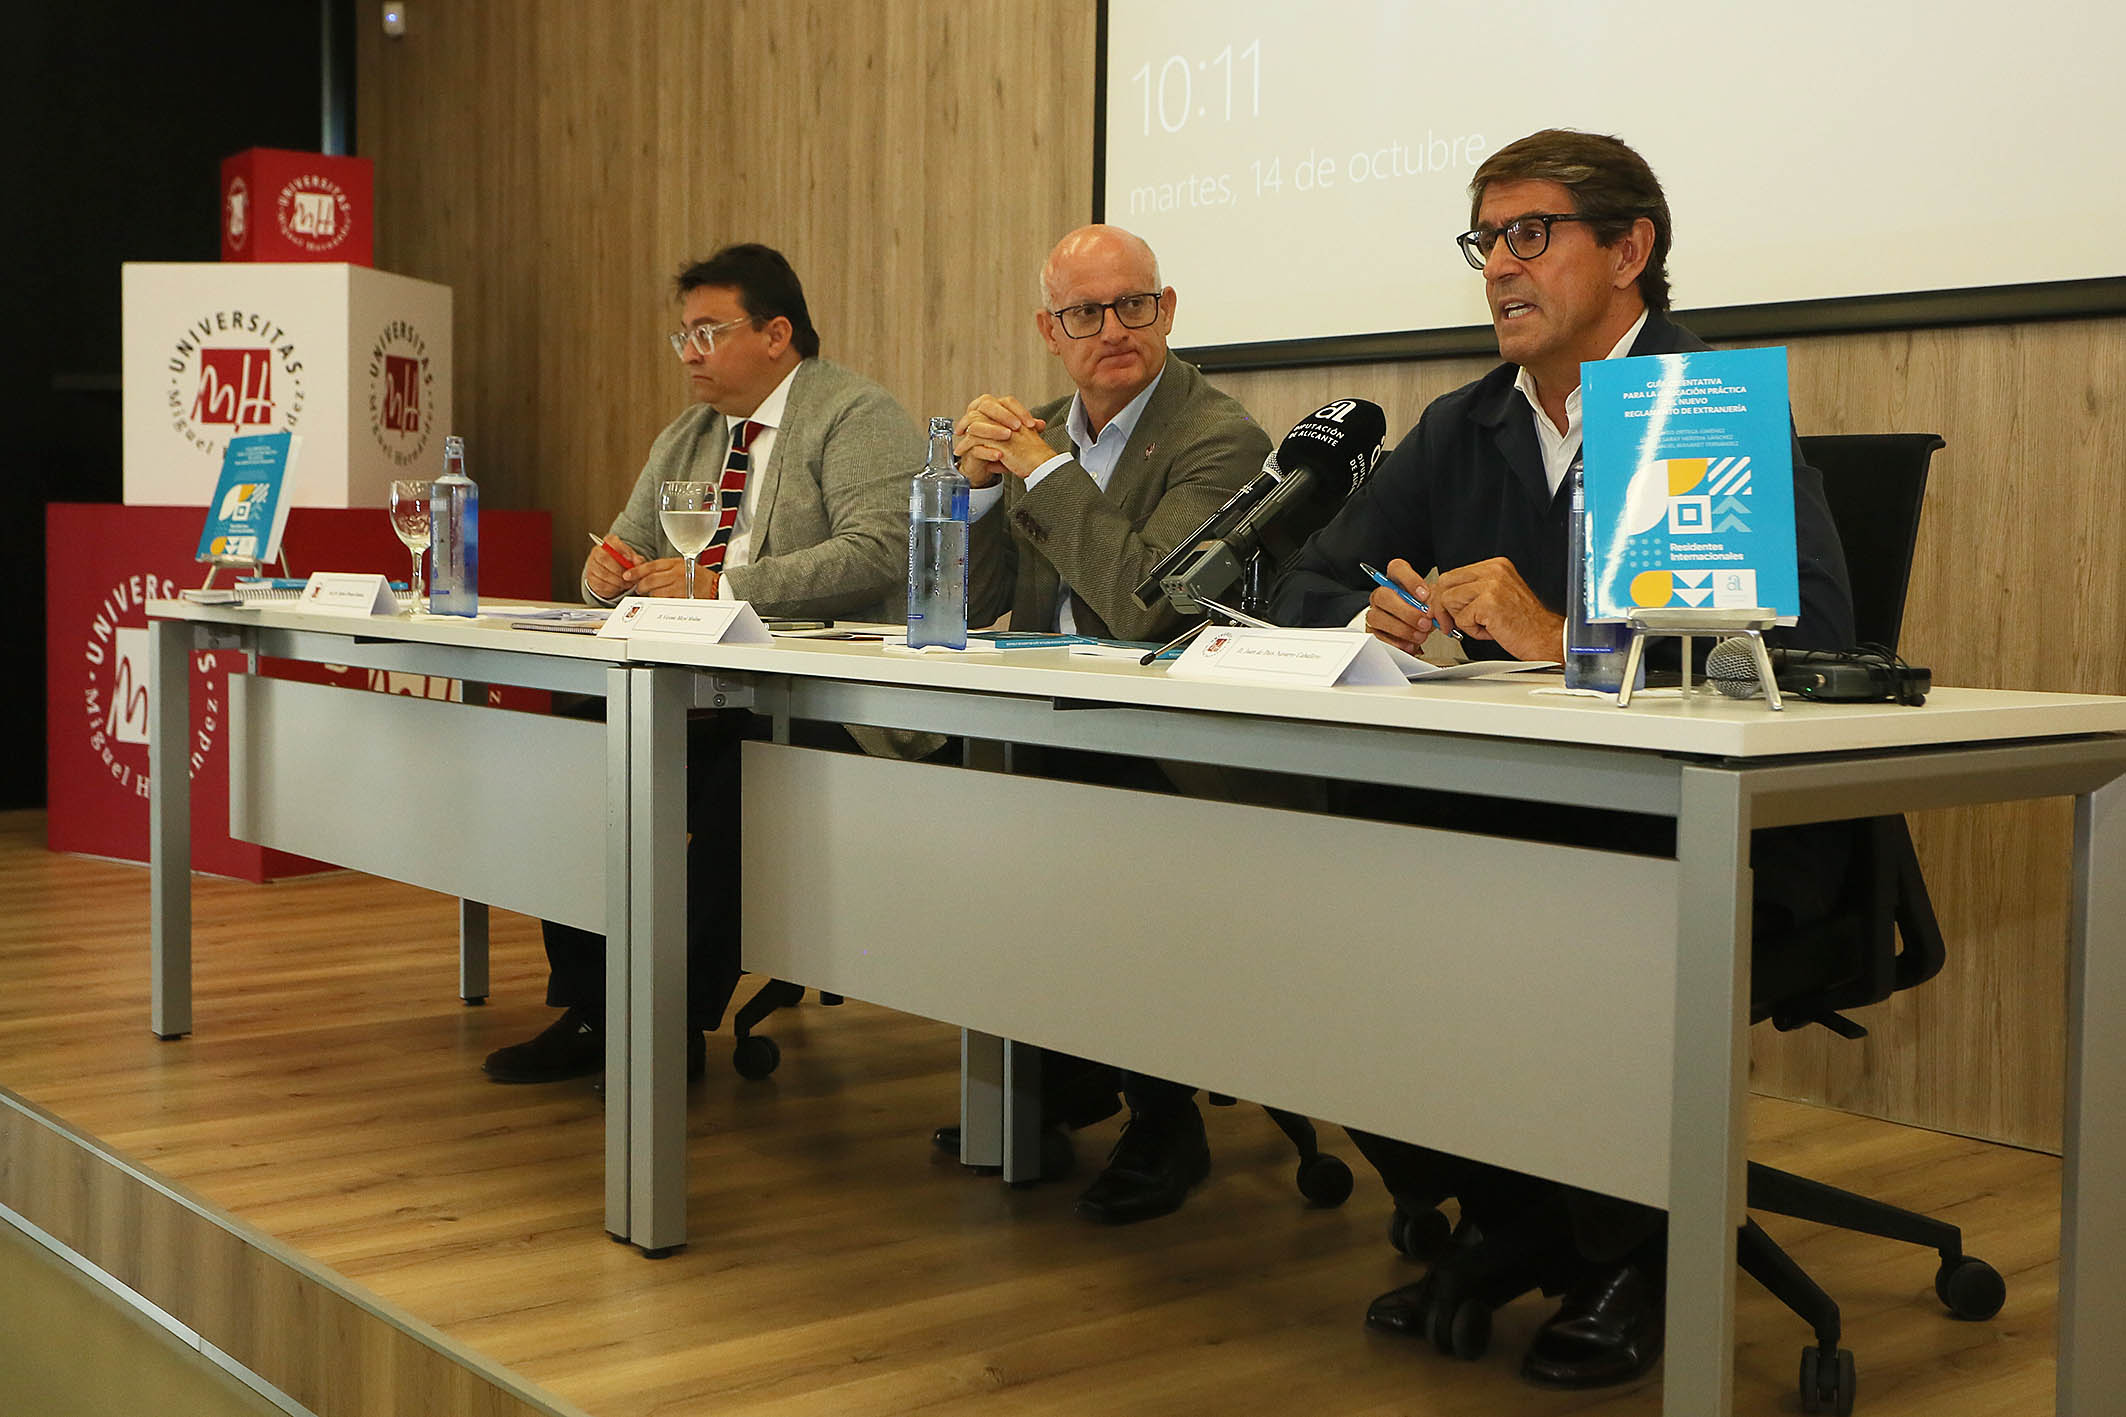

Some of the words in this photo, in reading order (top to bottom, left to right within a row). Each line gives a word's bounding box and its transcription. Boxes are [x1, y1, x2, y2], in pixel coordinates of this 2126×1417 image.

[1132, 39, 1262, 136] 10:11
[1130, 172, 1240, 215] martes,
[1249, 156, 1283, 197] 14
[1295, 148, 1336, 191] de
[1348, 128, 1487, 184] octubre
[278, 175, 351, 211] UNIVERSITAS
[169, 310, 303, 375] UNIVERSITAS
[369, 320, 433, 386] UNIVERSITAS
[1670, 378, 1723, 388] ENTATIVA
[1623, 391, 1645, 400] PARA
[1646, 390, 1657, 398] LA
[1678, 397, 1708, 405] NUEVO
[1624, 408, 1680, 418] REGLAMTO
[1297, 431, 1339, 447] ALICANTE
[1669, 542, 1724, 552] Residentes
[1670, 552, 1745, 561] Internacionales
[85, 688, 130, 786] Miguel
